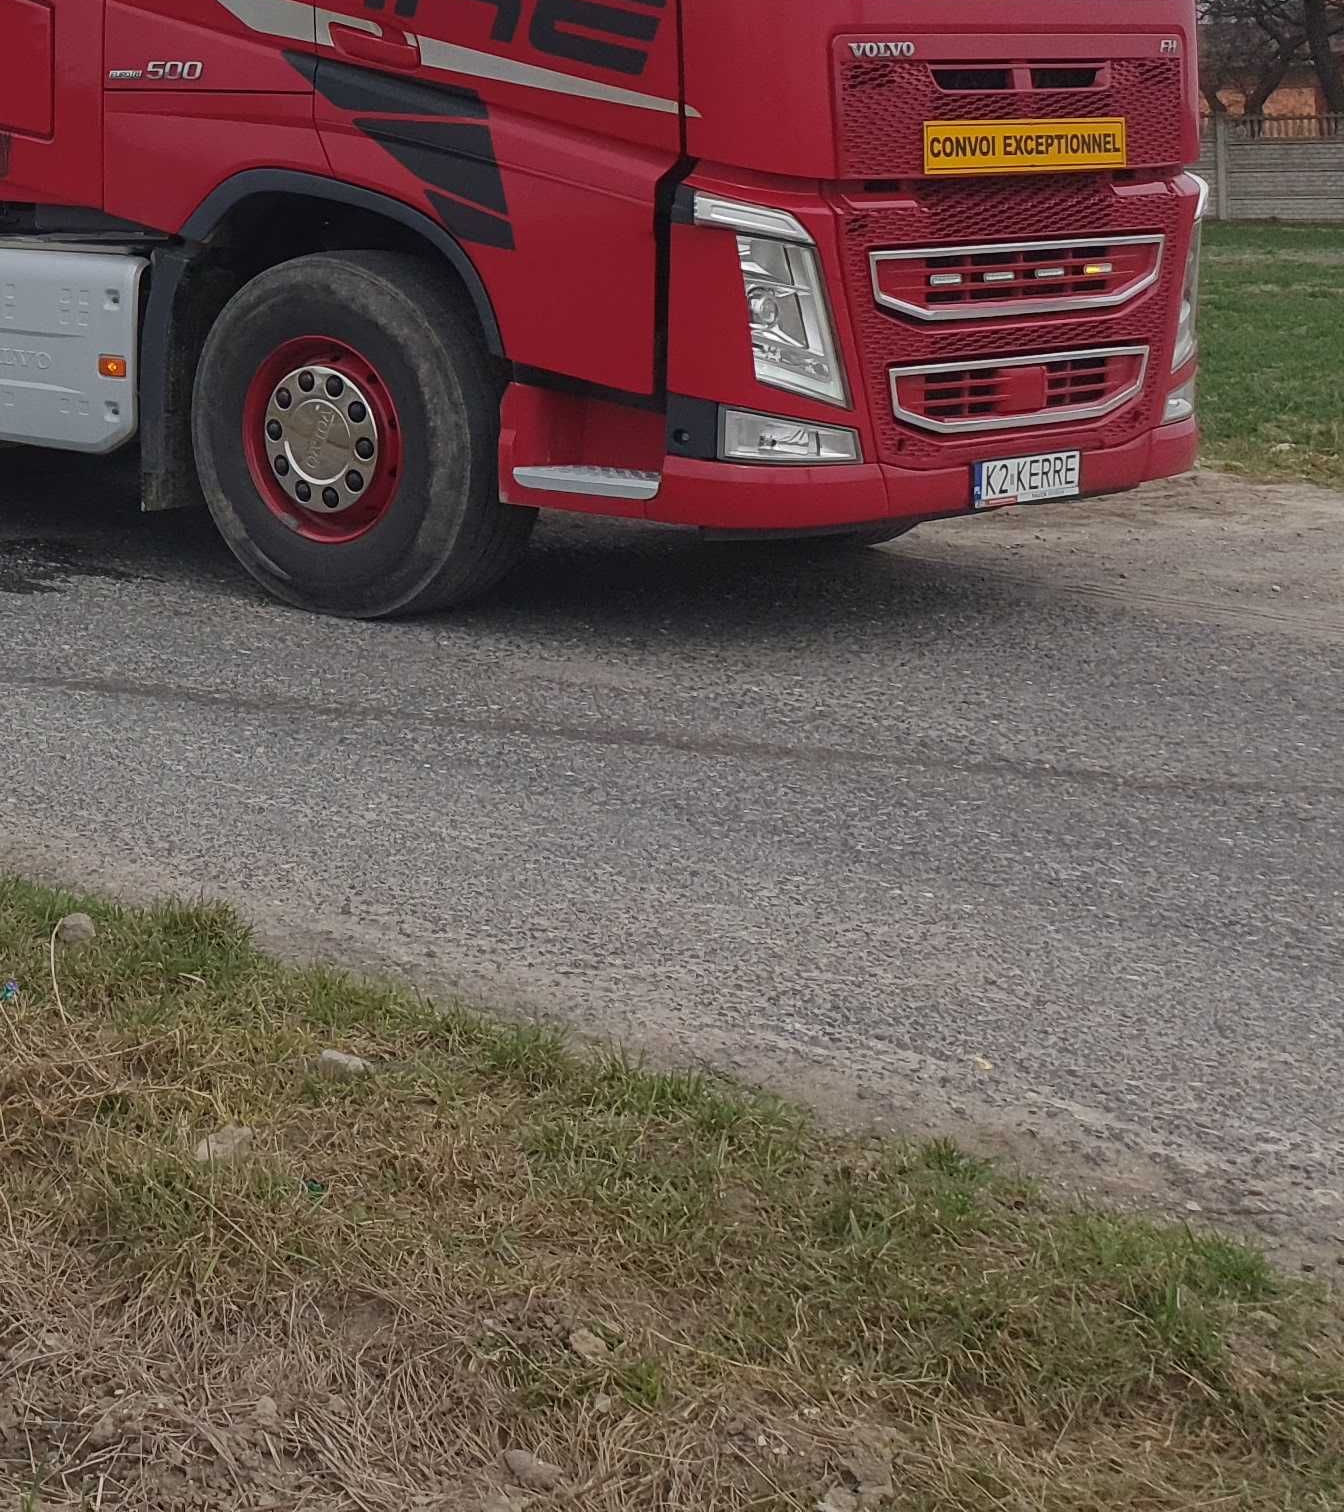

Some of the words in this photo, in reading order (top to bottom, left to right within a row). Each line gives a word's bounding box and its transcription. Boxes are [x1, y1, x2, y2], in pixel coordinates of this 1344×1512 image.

[848, 42, 915, 57] VOLVO
[146, 61, 203, 79] 500
[929, 135, 997, 158] CONVOI
[1003, 133, 1121, 156] EXCEPTIONNEL
[985, 463, 1010, 497] K2
[1016, 454, 1077, 492] KERRE
